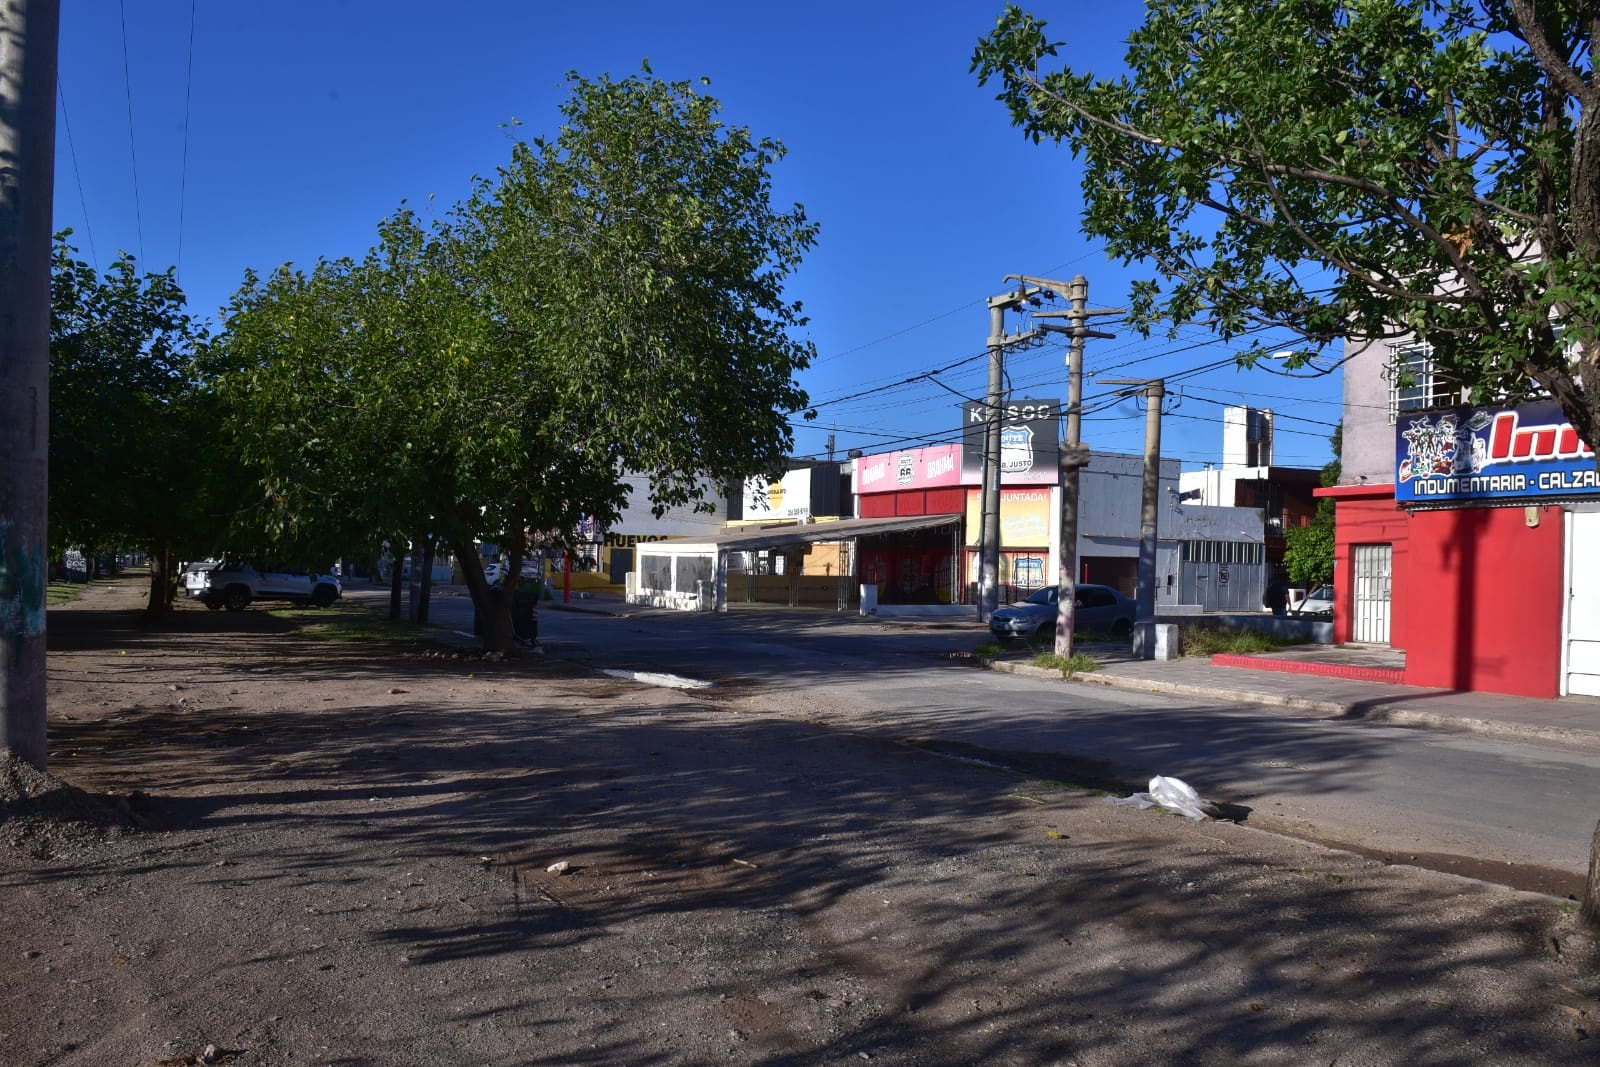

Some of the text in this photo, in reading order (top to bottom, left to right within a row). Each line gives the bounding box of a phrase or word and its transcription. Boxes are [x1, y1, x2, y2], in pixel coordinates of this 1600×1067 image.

[970, 405, 1050, 422] KSCO
[1009, 460, 1032, 468] JUSTO
[1415, 470, 1600, 495] INDUMENTARIA CALZA
